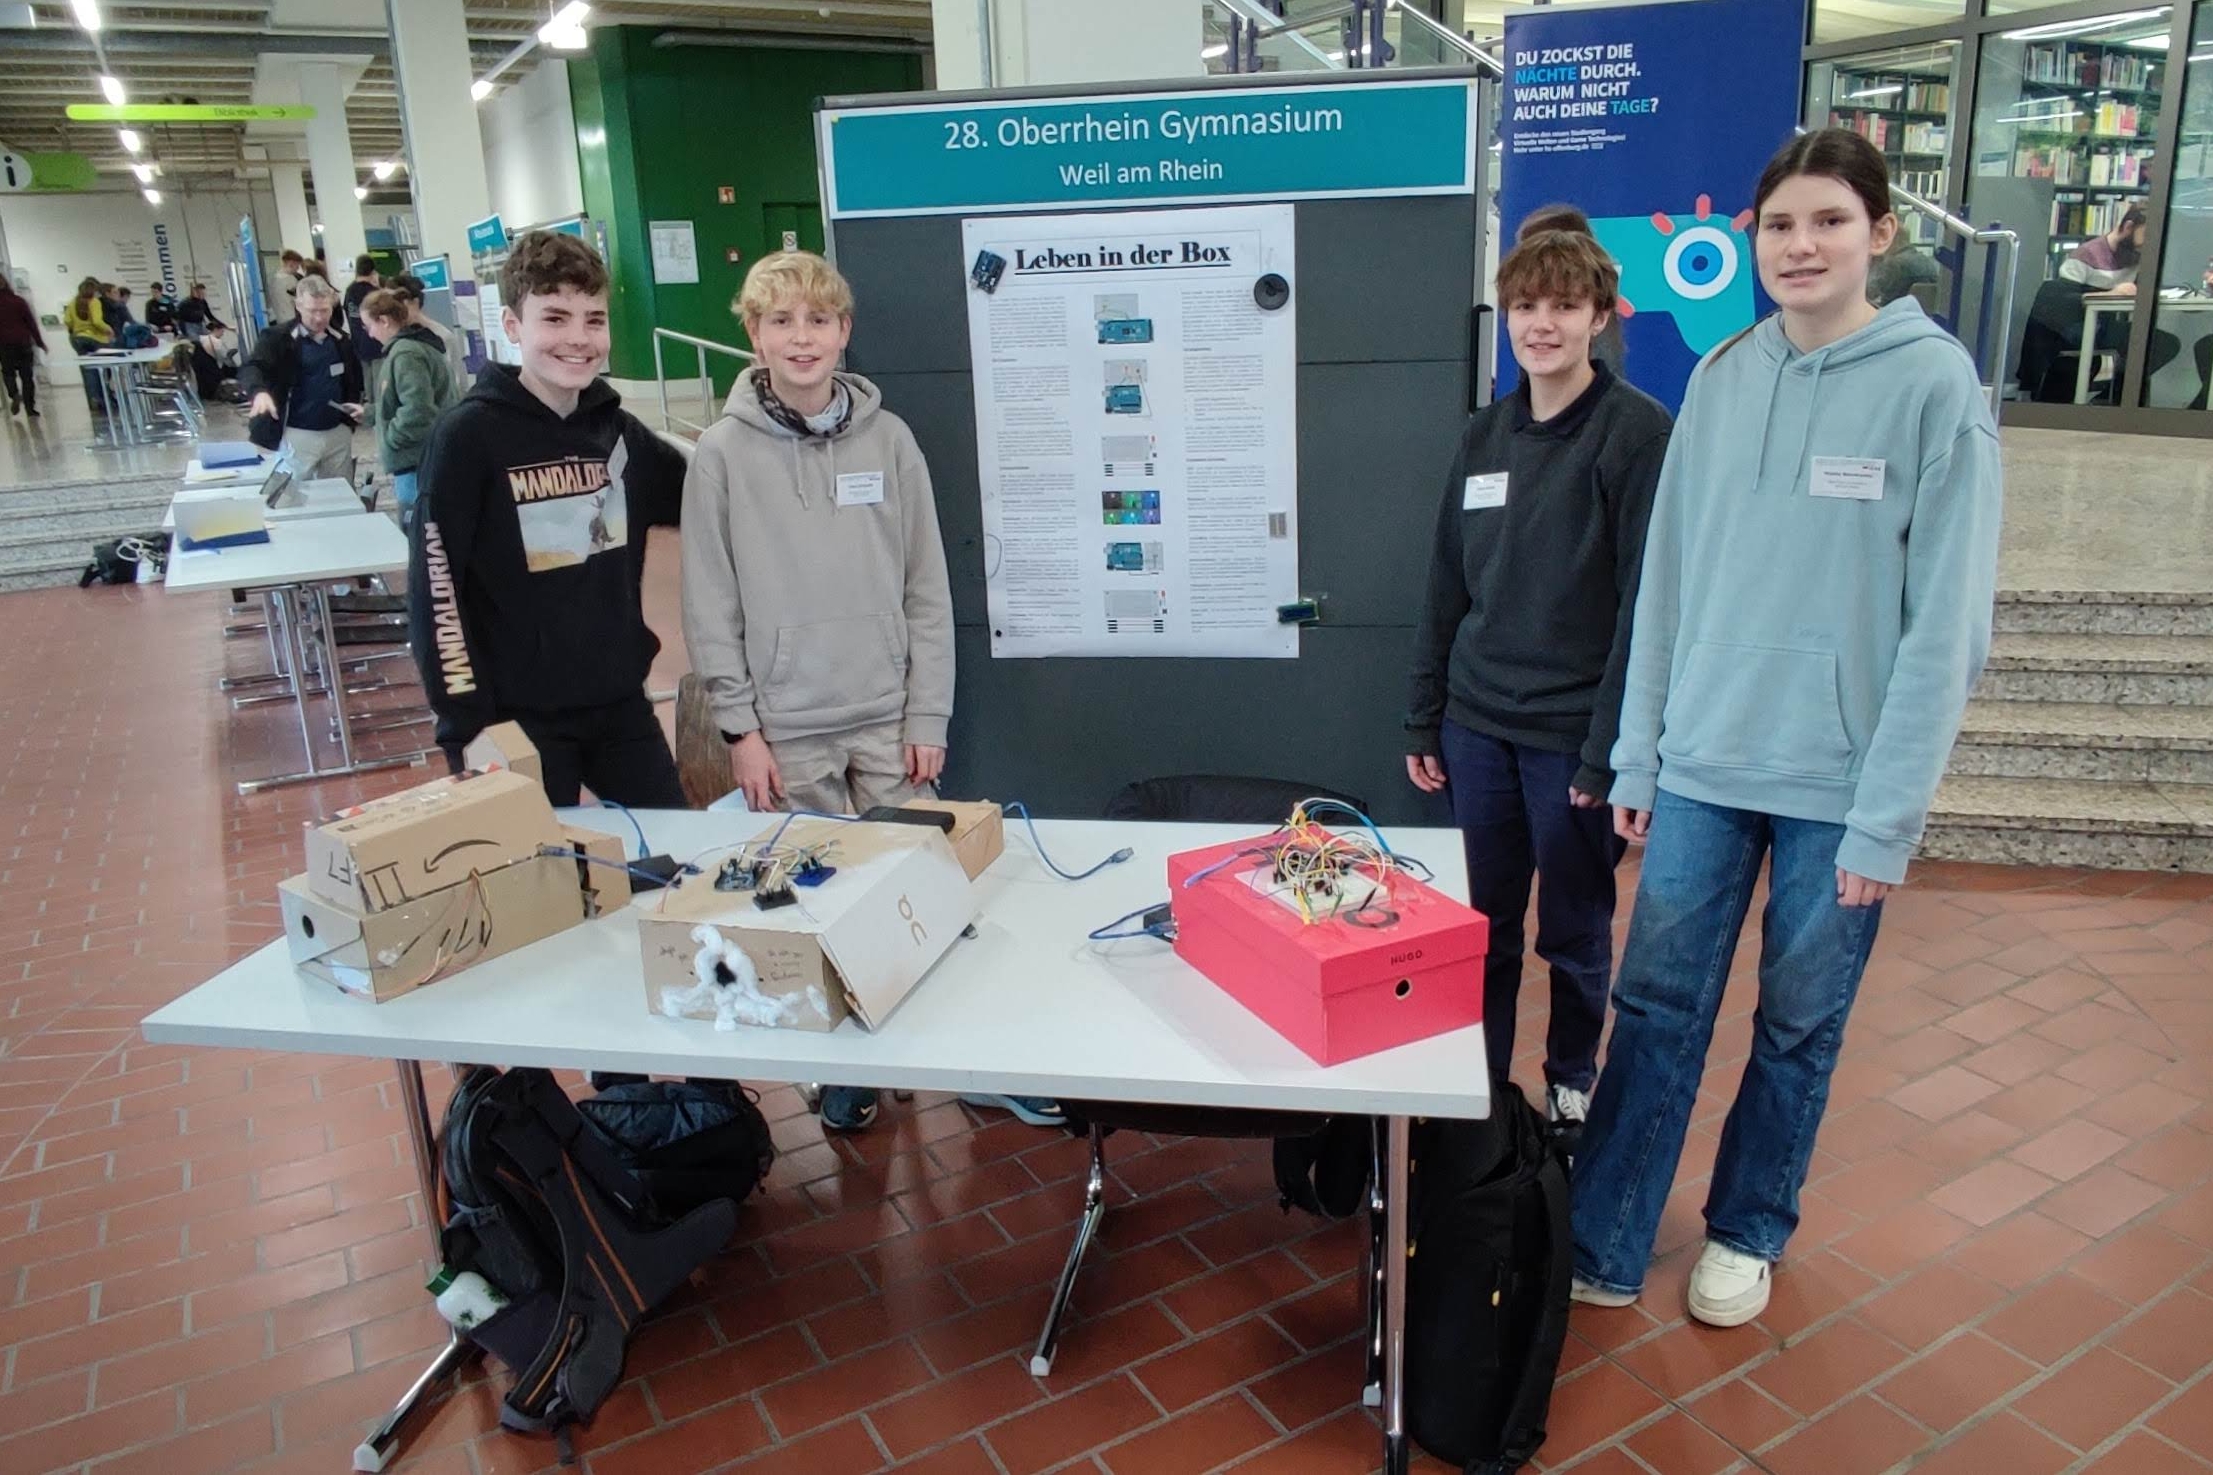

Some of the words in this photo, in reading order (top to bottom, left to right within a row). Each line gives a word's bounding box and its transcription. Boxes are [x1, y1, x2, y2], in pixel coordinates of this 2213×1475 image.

[1515, 50, 1538, 66] DU
[1541, 45, 1603, 64] ZOCKST
[1606, 43, 1633, 60] DIE
[1515, 65, 1577, 84] NÄCHTE
[1581, 62, 1641, 80] DURCH.
[1513, 85, 1574, 103] WARUM
[1581, 81, 1630, 99] NICHT
[1513, 104, 1557, 121] AUCH
[1560, 101, 1607, 118] DEINE
[1609, 97, 1659, 115] TAGE?
[943, 121, 988, 150] 28.
[997, 112, 1150, 147] Oberrhein
[1159, 104, 1342, 145] Gymnasium
[1058, 161, 1110, 187] Weil
[1116, 166, 1151, 184] am
[1159, 158, 1223, 182] Rhein
[1014, 247, 1093, 271] Leben
[1099, 245, 1123, 267] in
[1130, 243, 1173, 266] der
[1180, 241, 1232, 264] Box
[424, 521, 477, 696] MANDALORIAN
[1390, 949, 1423, 966] HUGO
